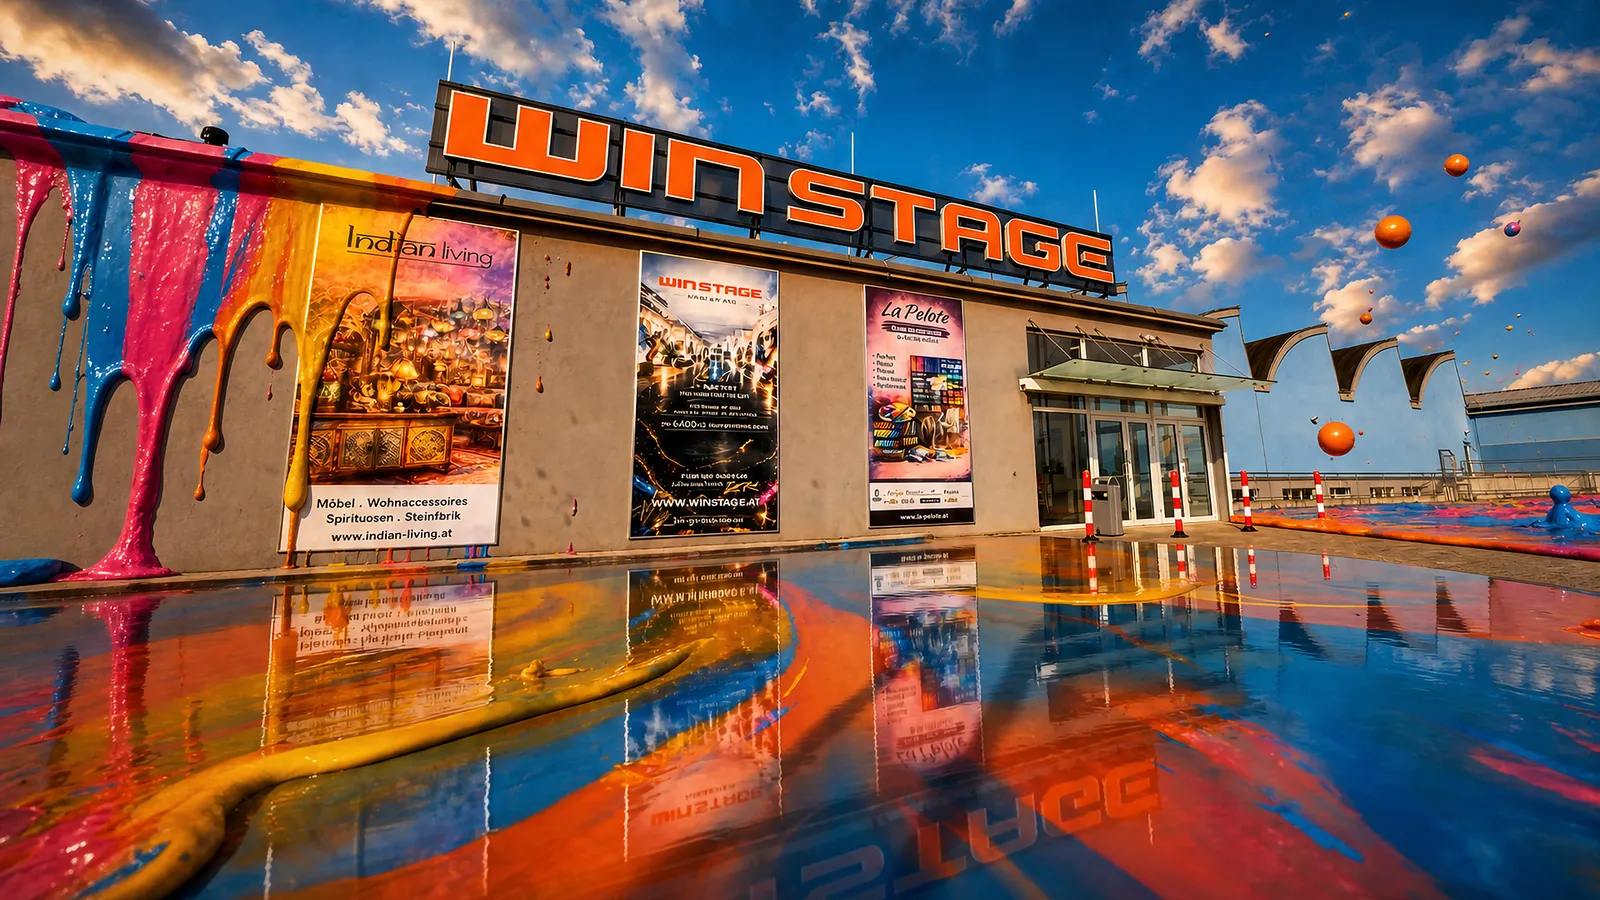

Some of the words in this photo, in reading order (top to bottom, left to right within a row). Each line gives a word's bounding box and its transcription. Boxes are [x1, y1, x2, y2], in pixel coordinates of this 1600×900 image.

[441, 241, 493, 269] living
[658, 275, 763, 300] WINSTAGE
[881, 301, 902, 319] La
[904, 304, 950, 324] Pelote
[316, 498, 356, 509] Möbel
[367, 496, 468, 508] Wohnaccessoires
[651, 498, 760, 508] WWW.WINSTAGE.AT
[326, 513, 394, 526] Spirituosen
[331, 528, 453, 542] www.indian-living.at
